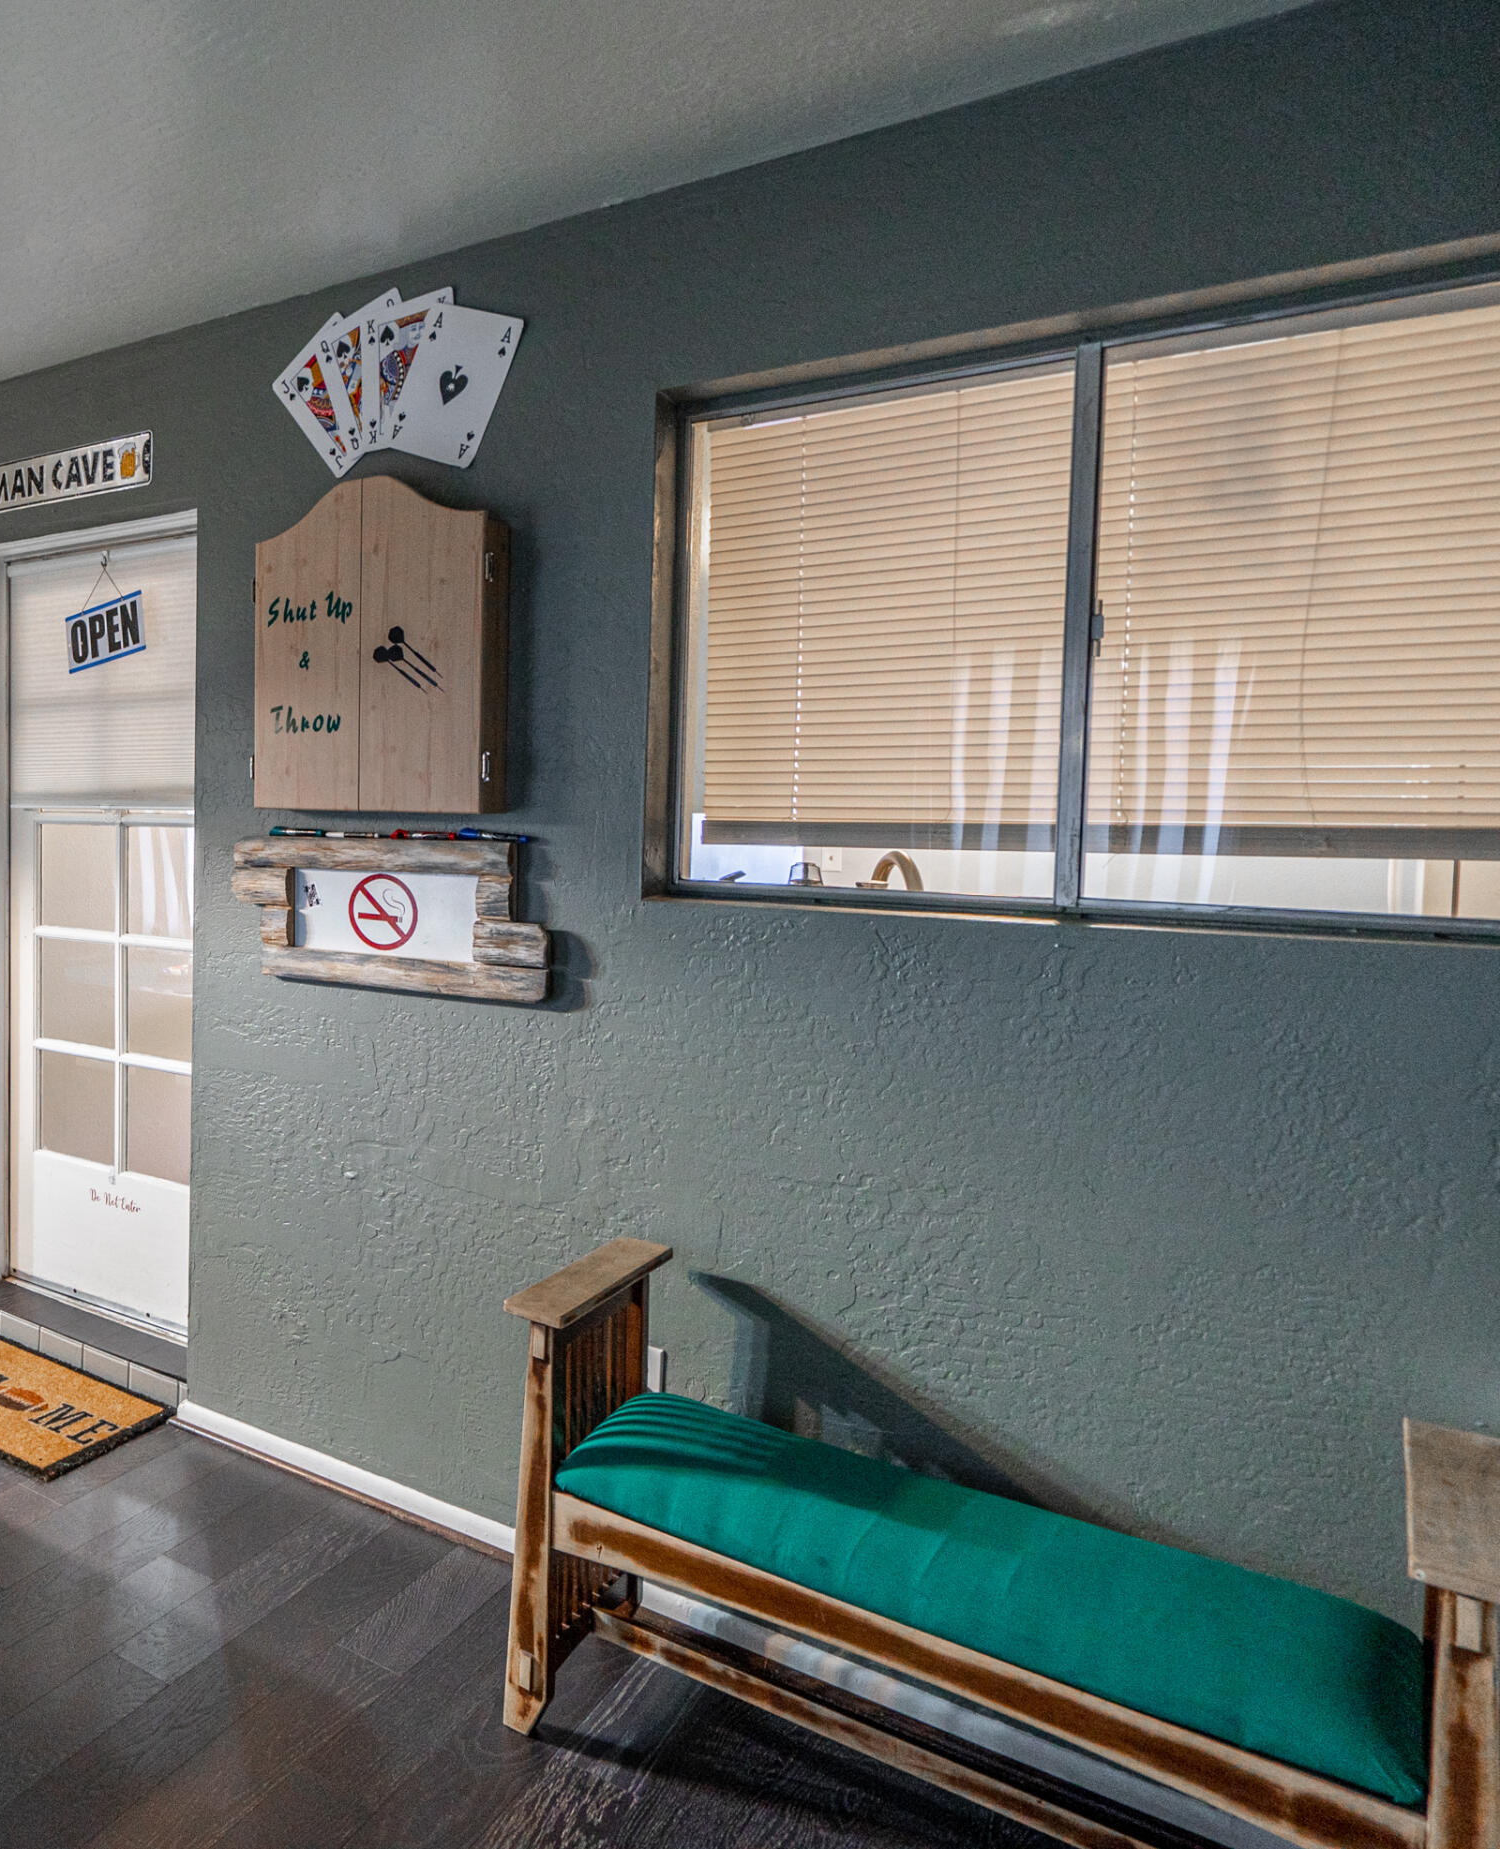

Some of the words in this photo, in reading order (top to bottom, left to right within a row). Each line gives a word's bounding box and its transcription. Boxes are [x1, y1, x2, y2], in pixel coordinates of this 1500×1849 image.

[433, 312, 443, 328] A
[501, 326, 512, 343] A
[52, 449, 114, 490] CAVE
[268, 597, 317, 627] Shut
[325, 590, 353, 624] Up
[71, 600, 140, 664] OPEN
[299, 651, 310, 670] &
[270, 705, 341, 734] Throw
